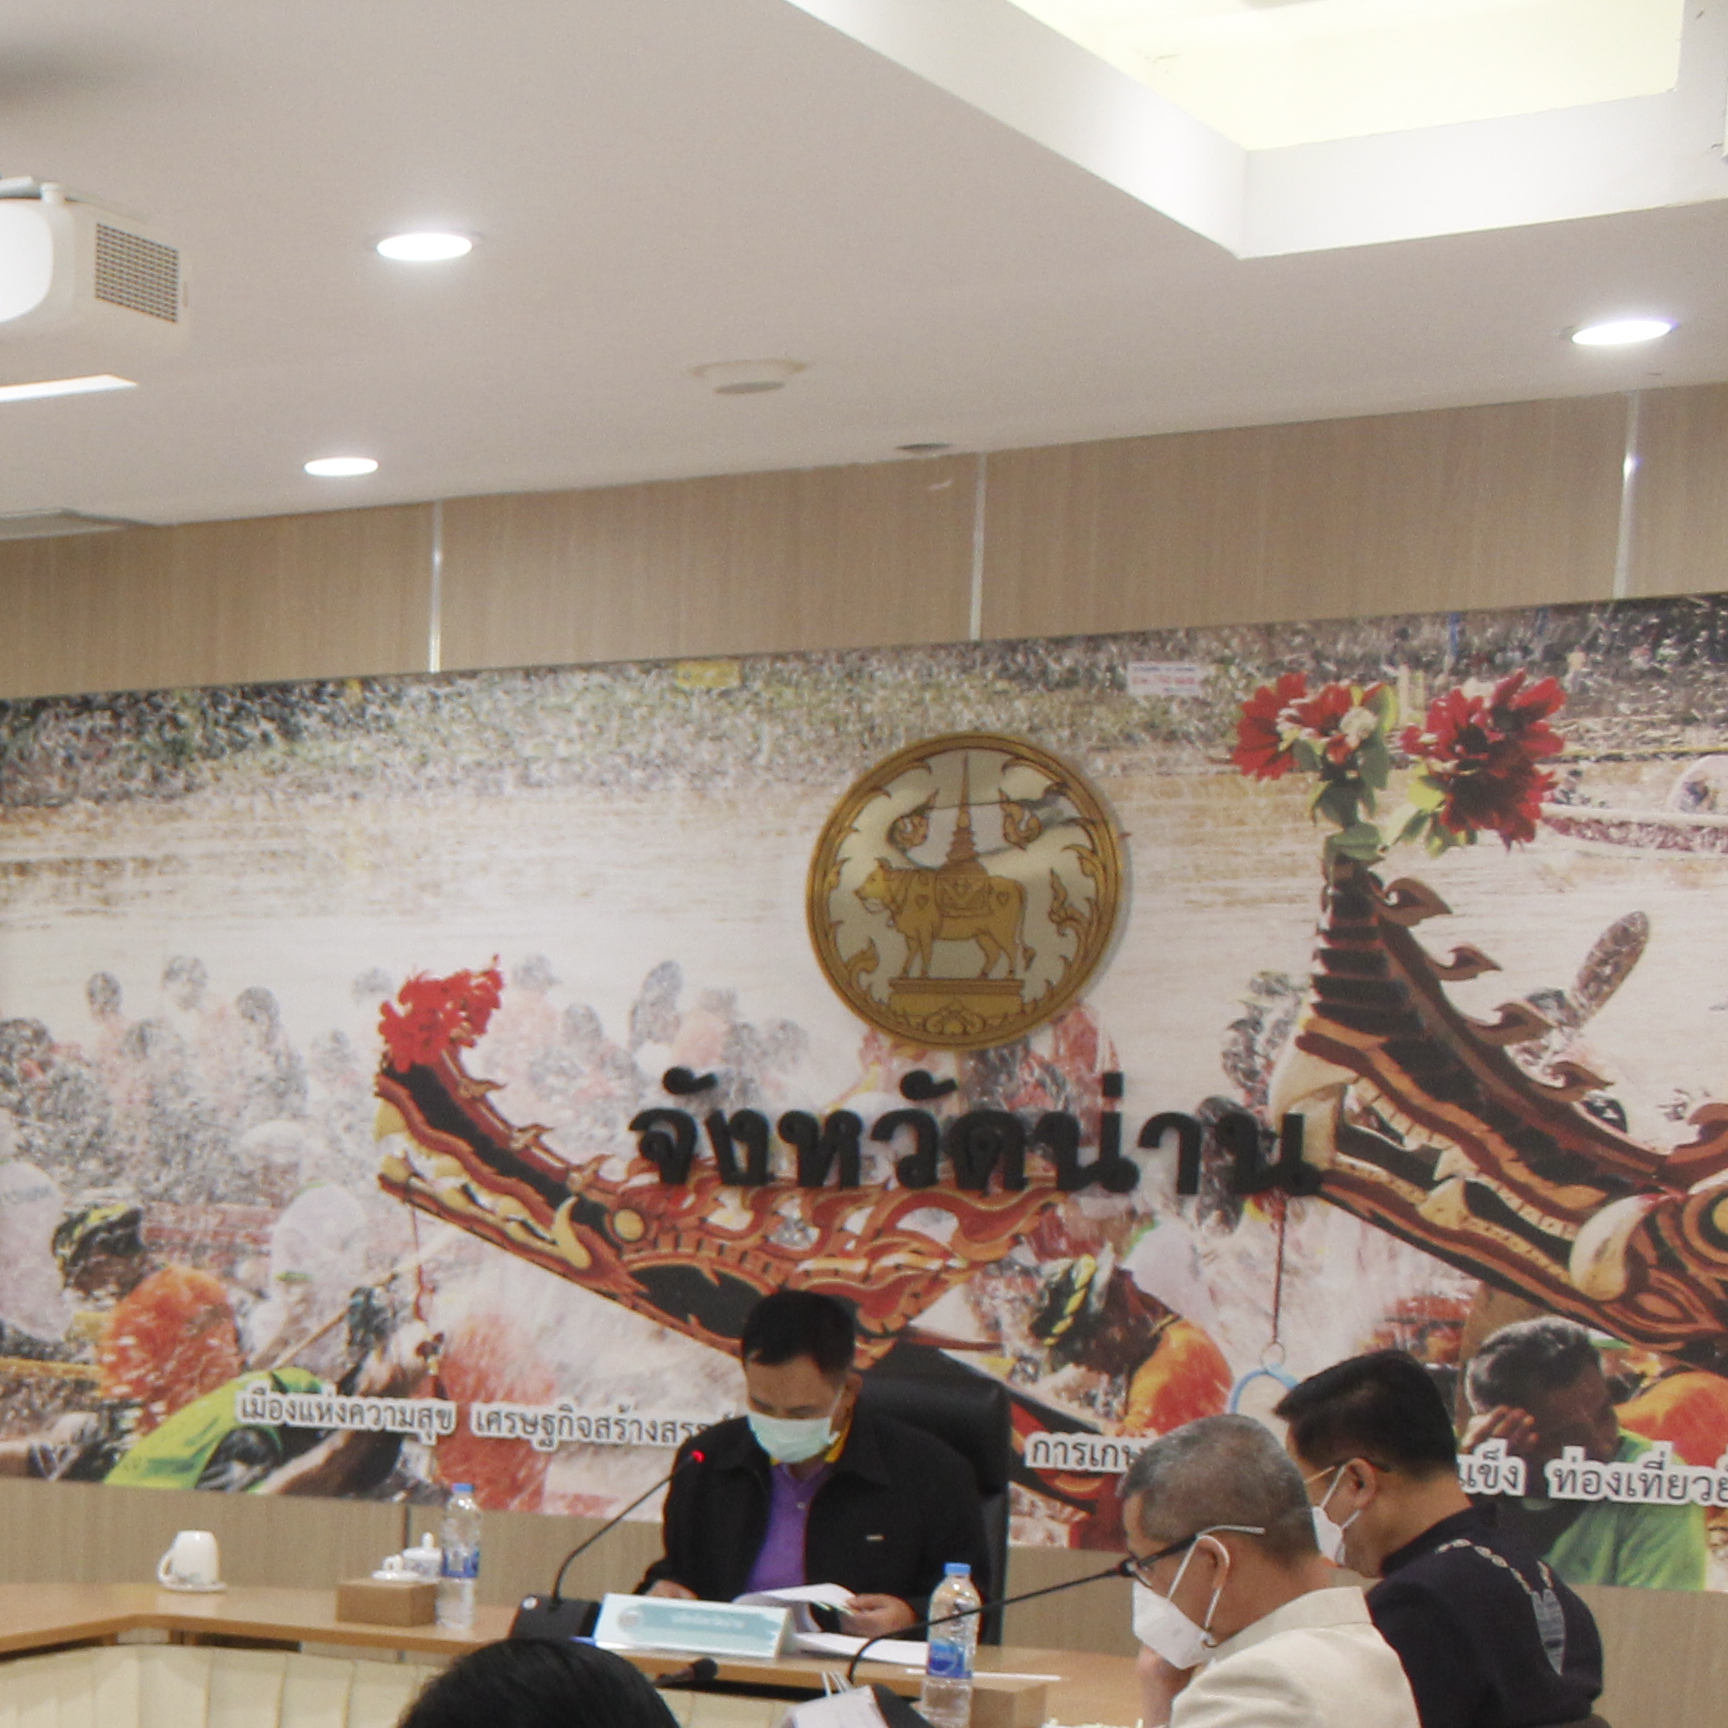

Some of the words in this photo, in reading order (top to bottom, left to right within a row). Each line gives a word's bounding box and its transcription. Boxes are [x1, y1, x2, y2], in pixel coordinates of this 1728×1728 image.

[629, 1066, 1322, 1197] จังหวัดน่าน
[243, 1386, 454, 1441] เมืองแห่งความสุข
[476, 1402, 734, 1447] เศรษฐกิจสร้างสร
